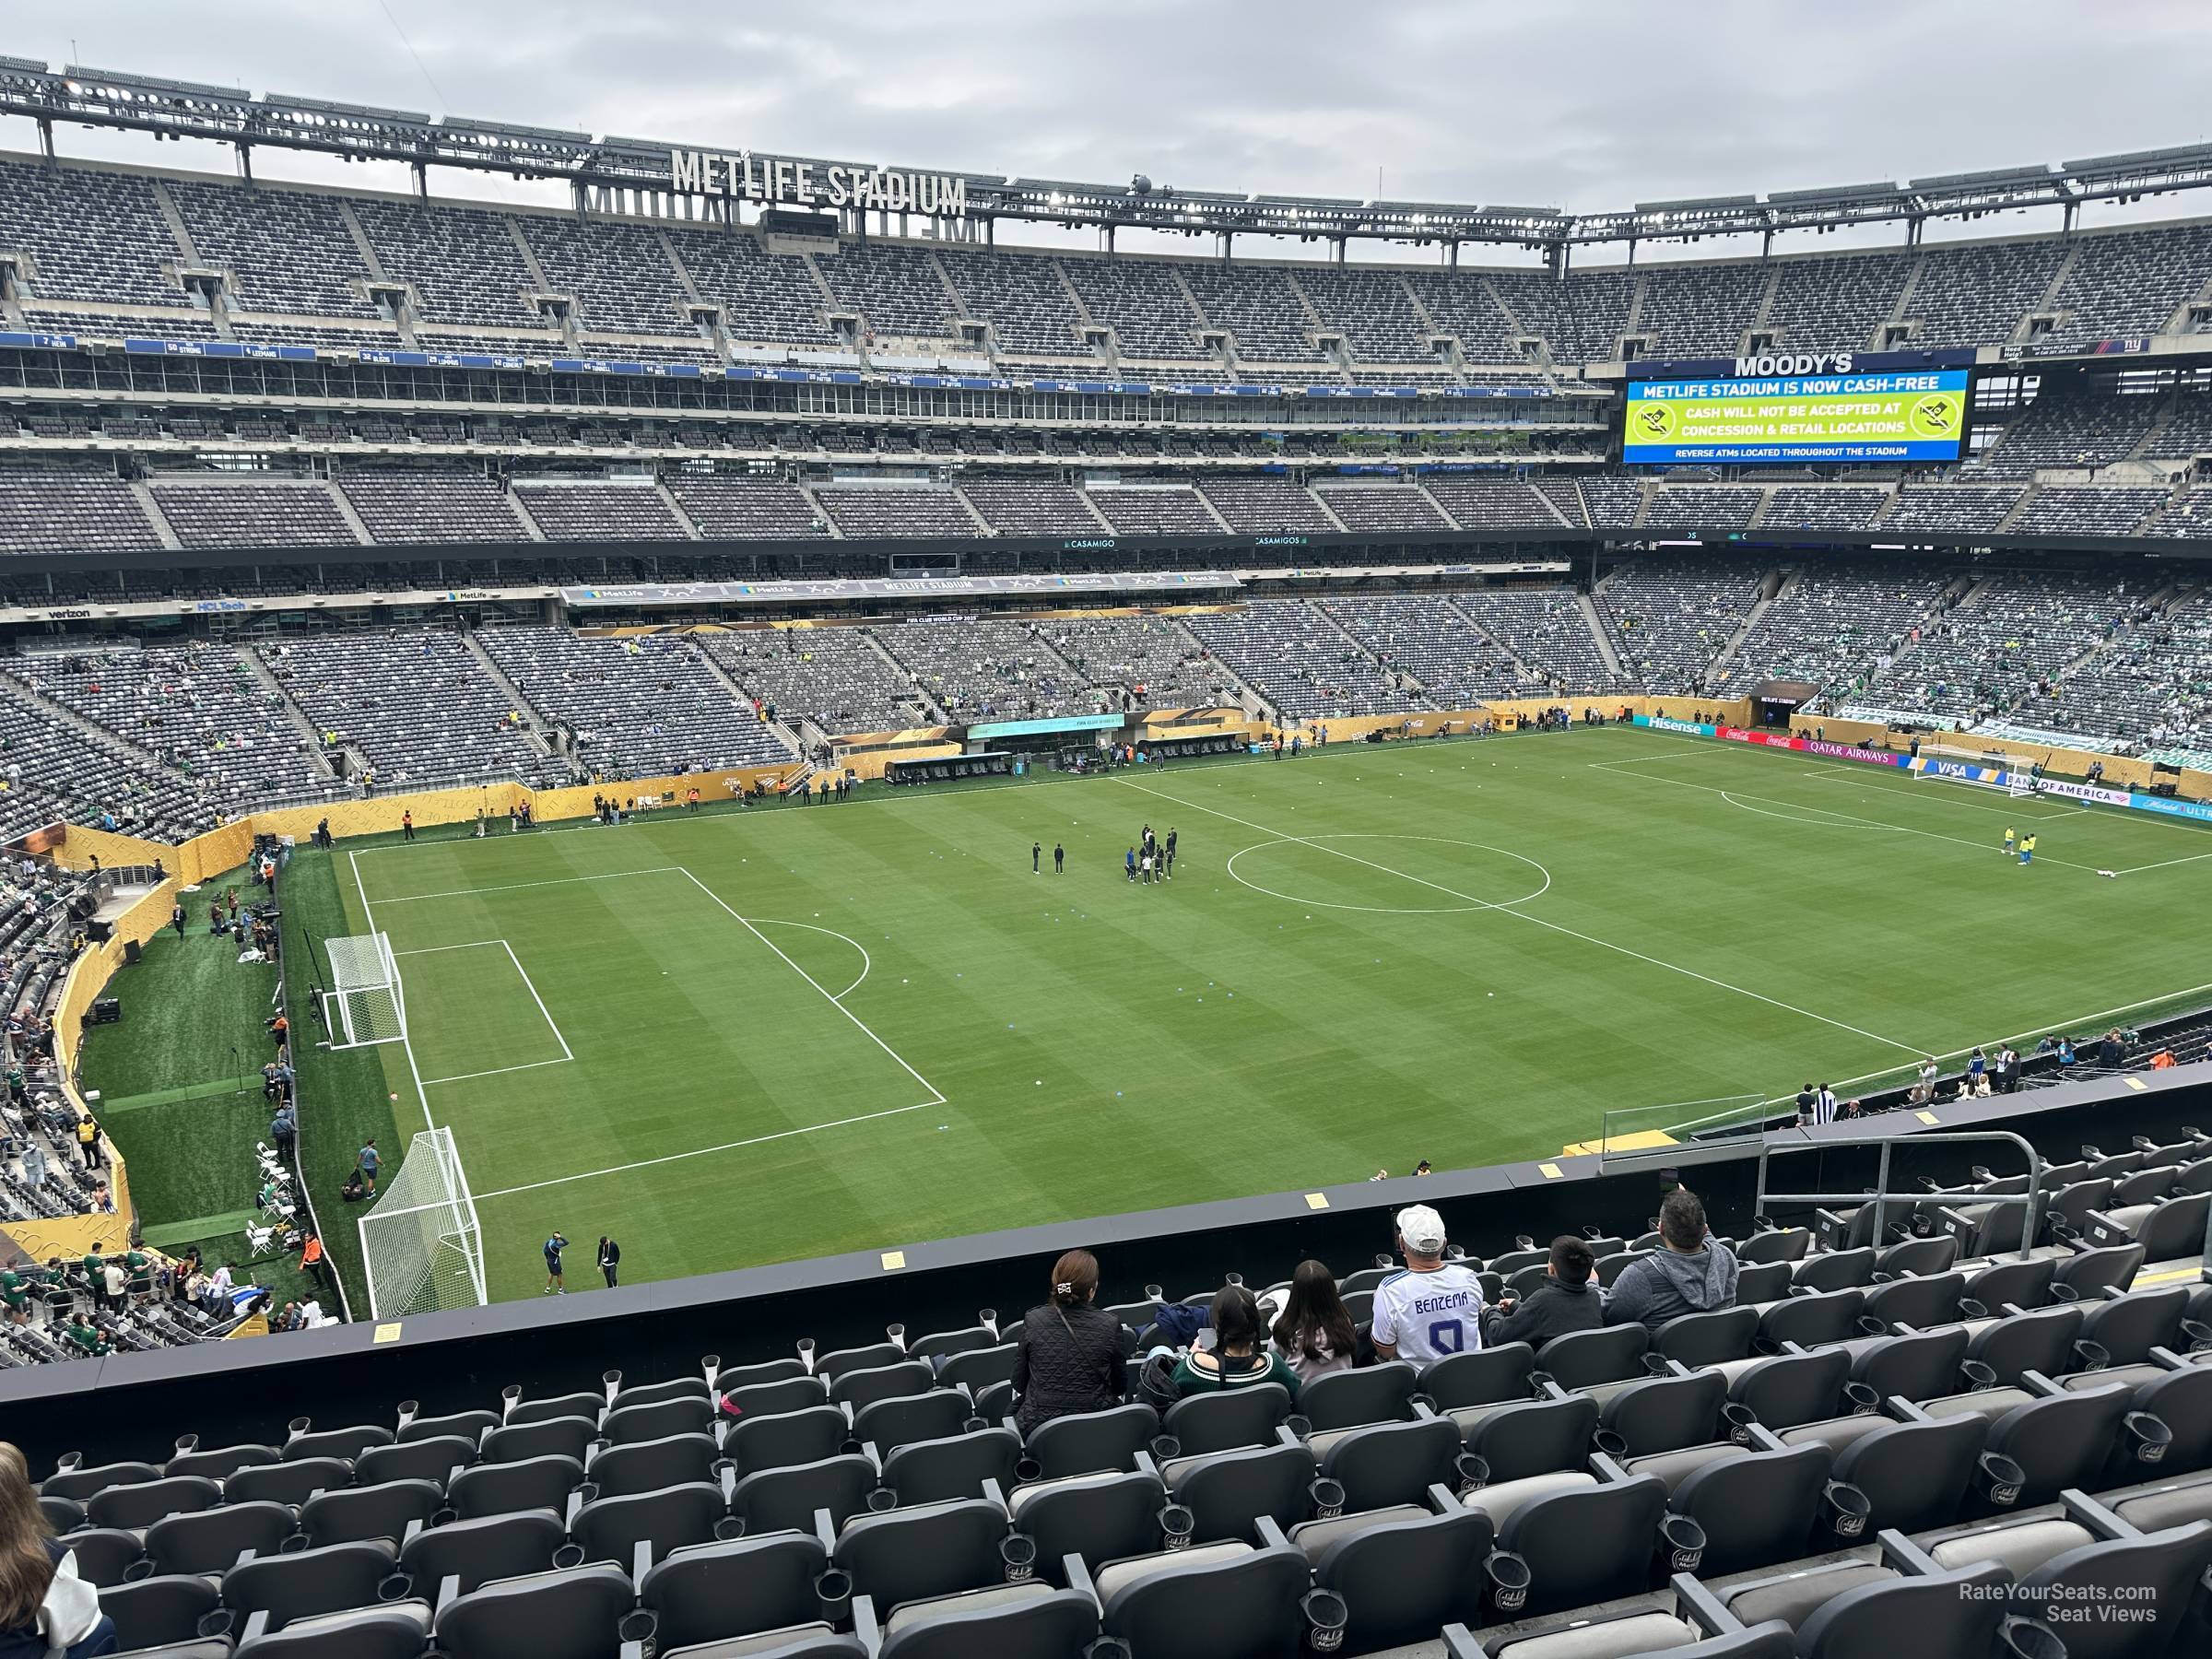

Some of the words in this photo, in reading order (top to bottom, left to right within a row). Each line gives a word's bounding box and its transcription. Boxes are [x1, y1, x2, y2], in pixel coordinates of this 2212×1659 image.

[671, 149, 815, 203] METLIFE
[827, 166, 965, 216] STADIUM
[168, 343, 178, 351] 50
[179, 346, 202, 354] STRONG
[1735, 353, 1852, 377] MOODY'S
[1643, 384, 1708, 398] METLIFE
[1711, 382, 1780, 396] STADIUM
[1783, 382, 1799, 394] IS
[1802, 380, 1841, 394] NOW
[1843, 376, 1939, 392] CASH-FREE
[1686, 407, 1722, 419] CASH
[1724, 406, 1756, 418] WILL
[1758, 406, 1786, 418] NOT
[1788, 406, 1806, 417] BE
[1808, 403, 1880, 416] ACCEPTED
[1883, 403, 1902, 414] AT
[1681, 425, 1763, 437] CONCESSION
[1766, 424, 1777, 435] &
[1780, 423, 1827, 435] RETAIL
[1829, 421, 1906, 434] LOCATIONS
[1676, 450, 1713, 458] REVERSE
[1715, 449, 1739, 457] ATMs
[1740, 449, 1780, 457] LOCATED
[1783, 447, 1844, 456] THROUGHOUT
[1845, 447, 1864, 455] THE
[1865, 447, 1907, 455] STADIUM
[1071, 540, 1115, 548] CASAMIGO
[885, 582, 928, 591] METLIFE
[929, 580, 974, 590] STADIUM
[49, 608, 90, 619] verizon
[1648, 717, 1701, 735] Hisense
[1810, 742, 1842, 757] QATAR
[1845, 747, 1888, 763] AIRWAYS
[1938, 761, 1968, 778] VISA
[2008, 775, 2030, 786] BAN
[2041, 781, 2055, 792] OF
[2058, 784, 2112, 801] AMERICA
[1415, 1291, 1468, 1314] BENZEMA
